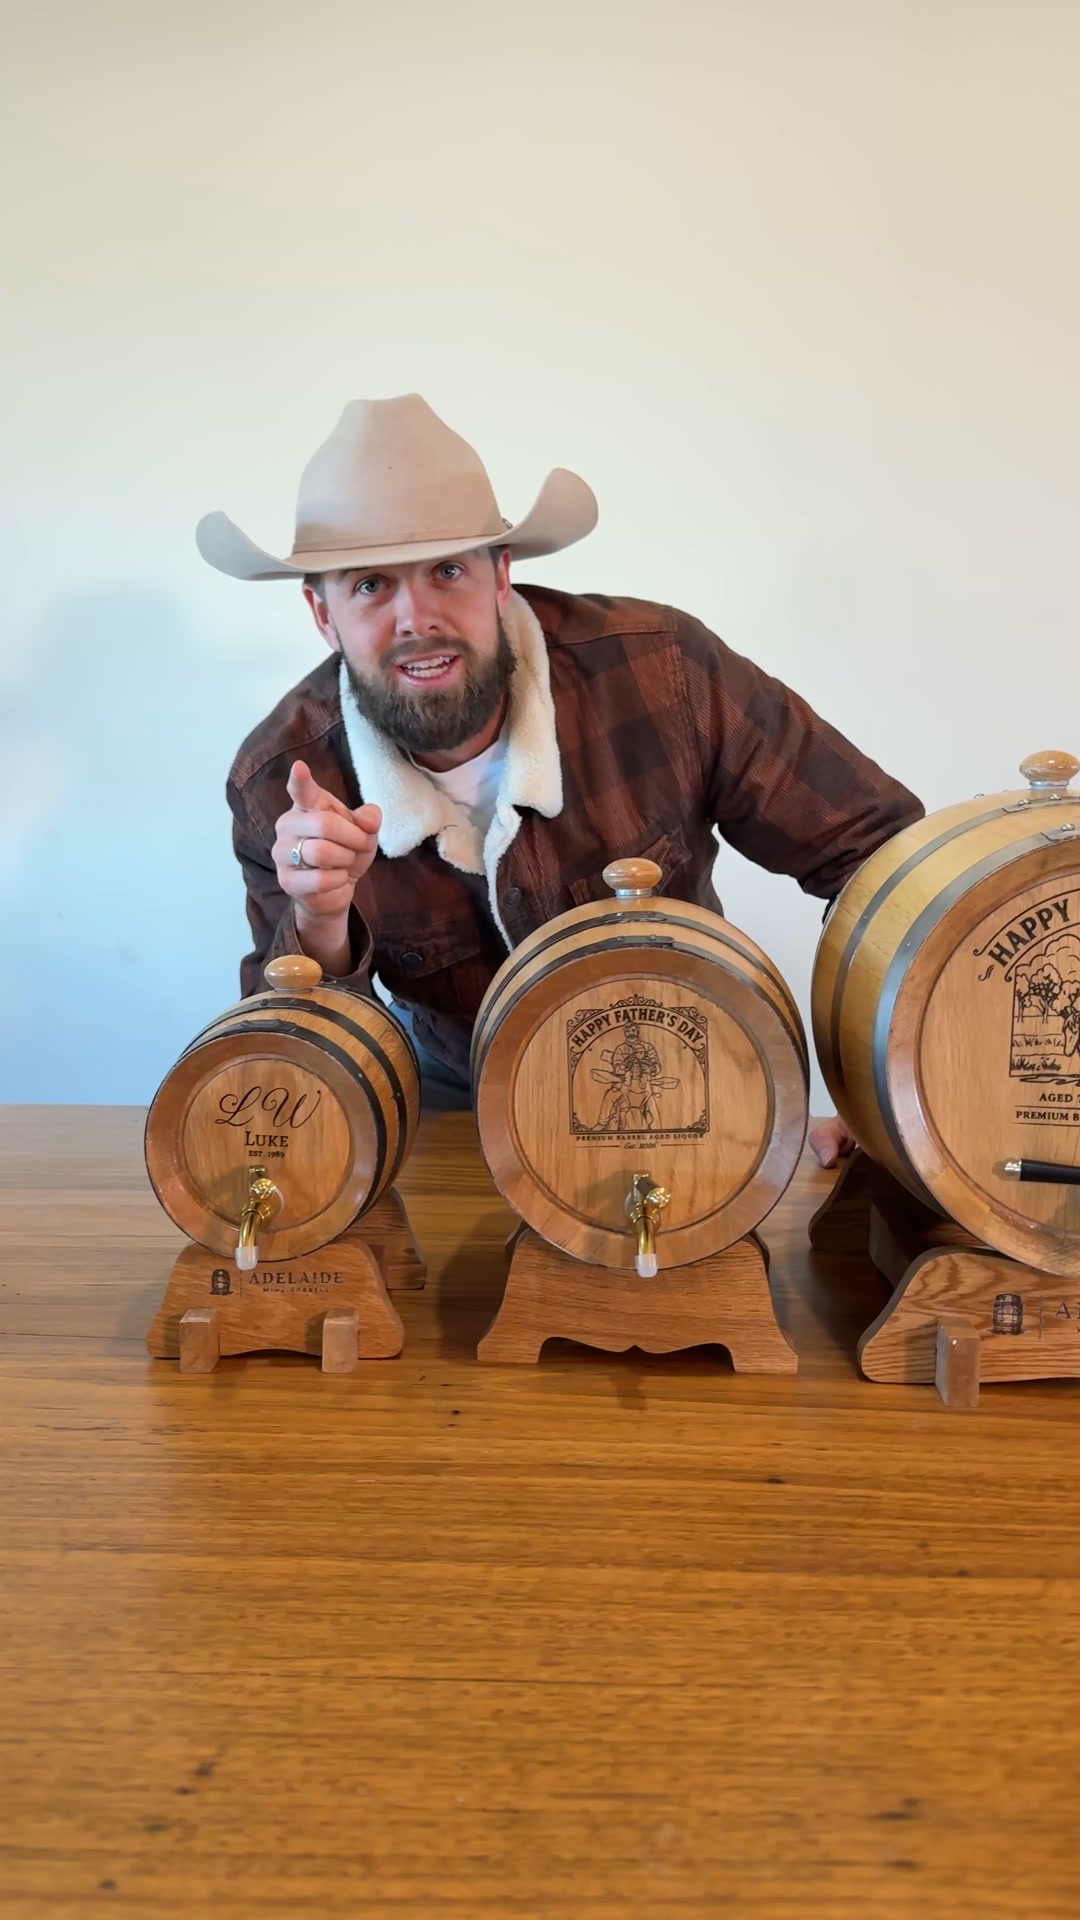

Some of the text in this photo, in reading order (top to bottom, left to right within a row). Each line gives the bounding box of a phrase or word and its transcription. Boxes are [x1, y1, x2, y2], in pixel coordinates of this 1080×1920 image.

[987, 898, 1070, 968] HAPPY
[571, 1008, 704, 1048] HAPPY FATHER'S DAY
[1039, 1093, 1074, 1103] AGED
[1015, 1111, 1069, 1121] PREMIUM
[248, 1272, 344, 1284] ADELAIDE
